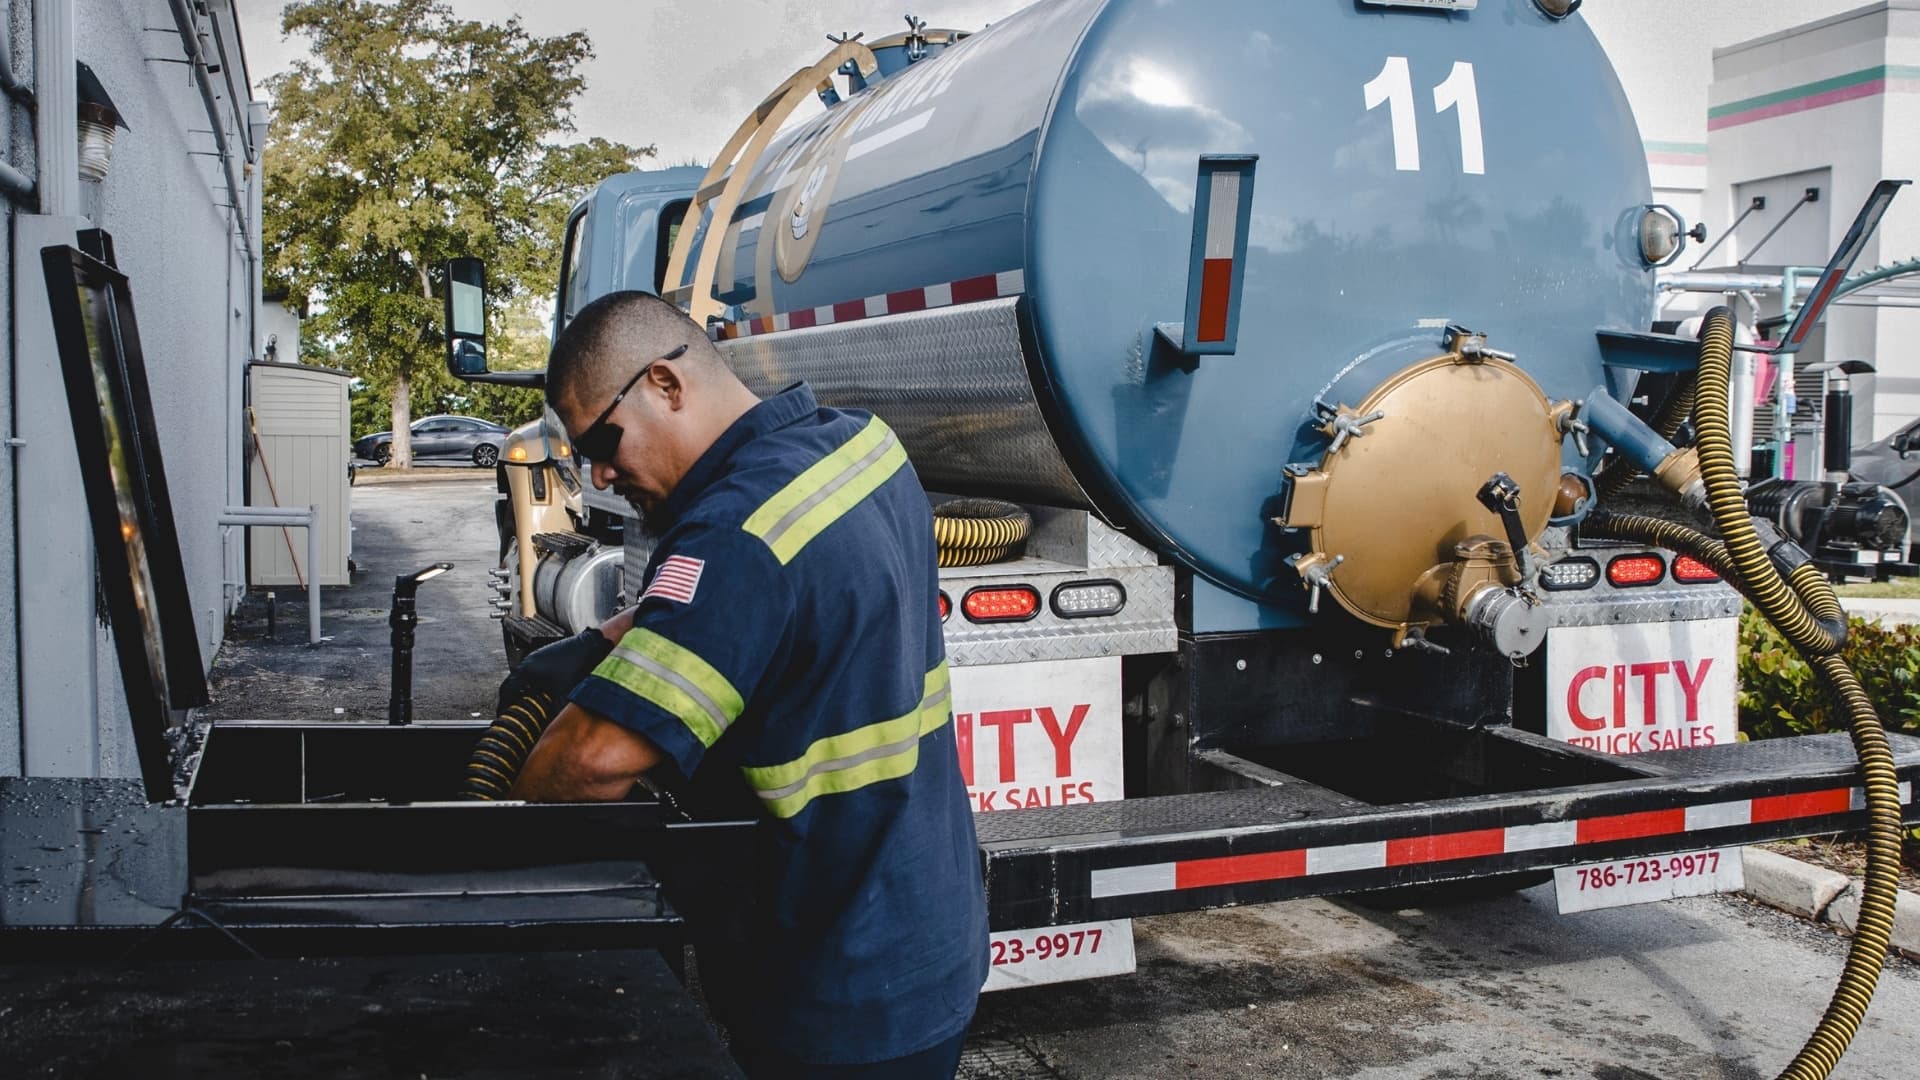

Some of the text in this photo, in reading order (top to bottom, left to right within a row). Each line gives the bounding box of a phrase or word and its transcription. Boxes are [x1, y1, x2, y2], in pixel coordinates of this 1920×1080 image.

[1363, 56, 1485, 175] 11
[1566, 658, 1714, 732] CITY
[1648, 725, 1716, 752] SALES
[1576, 851, 1720, 891] 786-723-9977
[990, 928, 1103, 966] 23-9977
